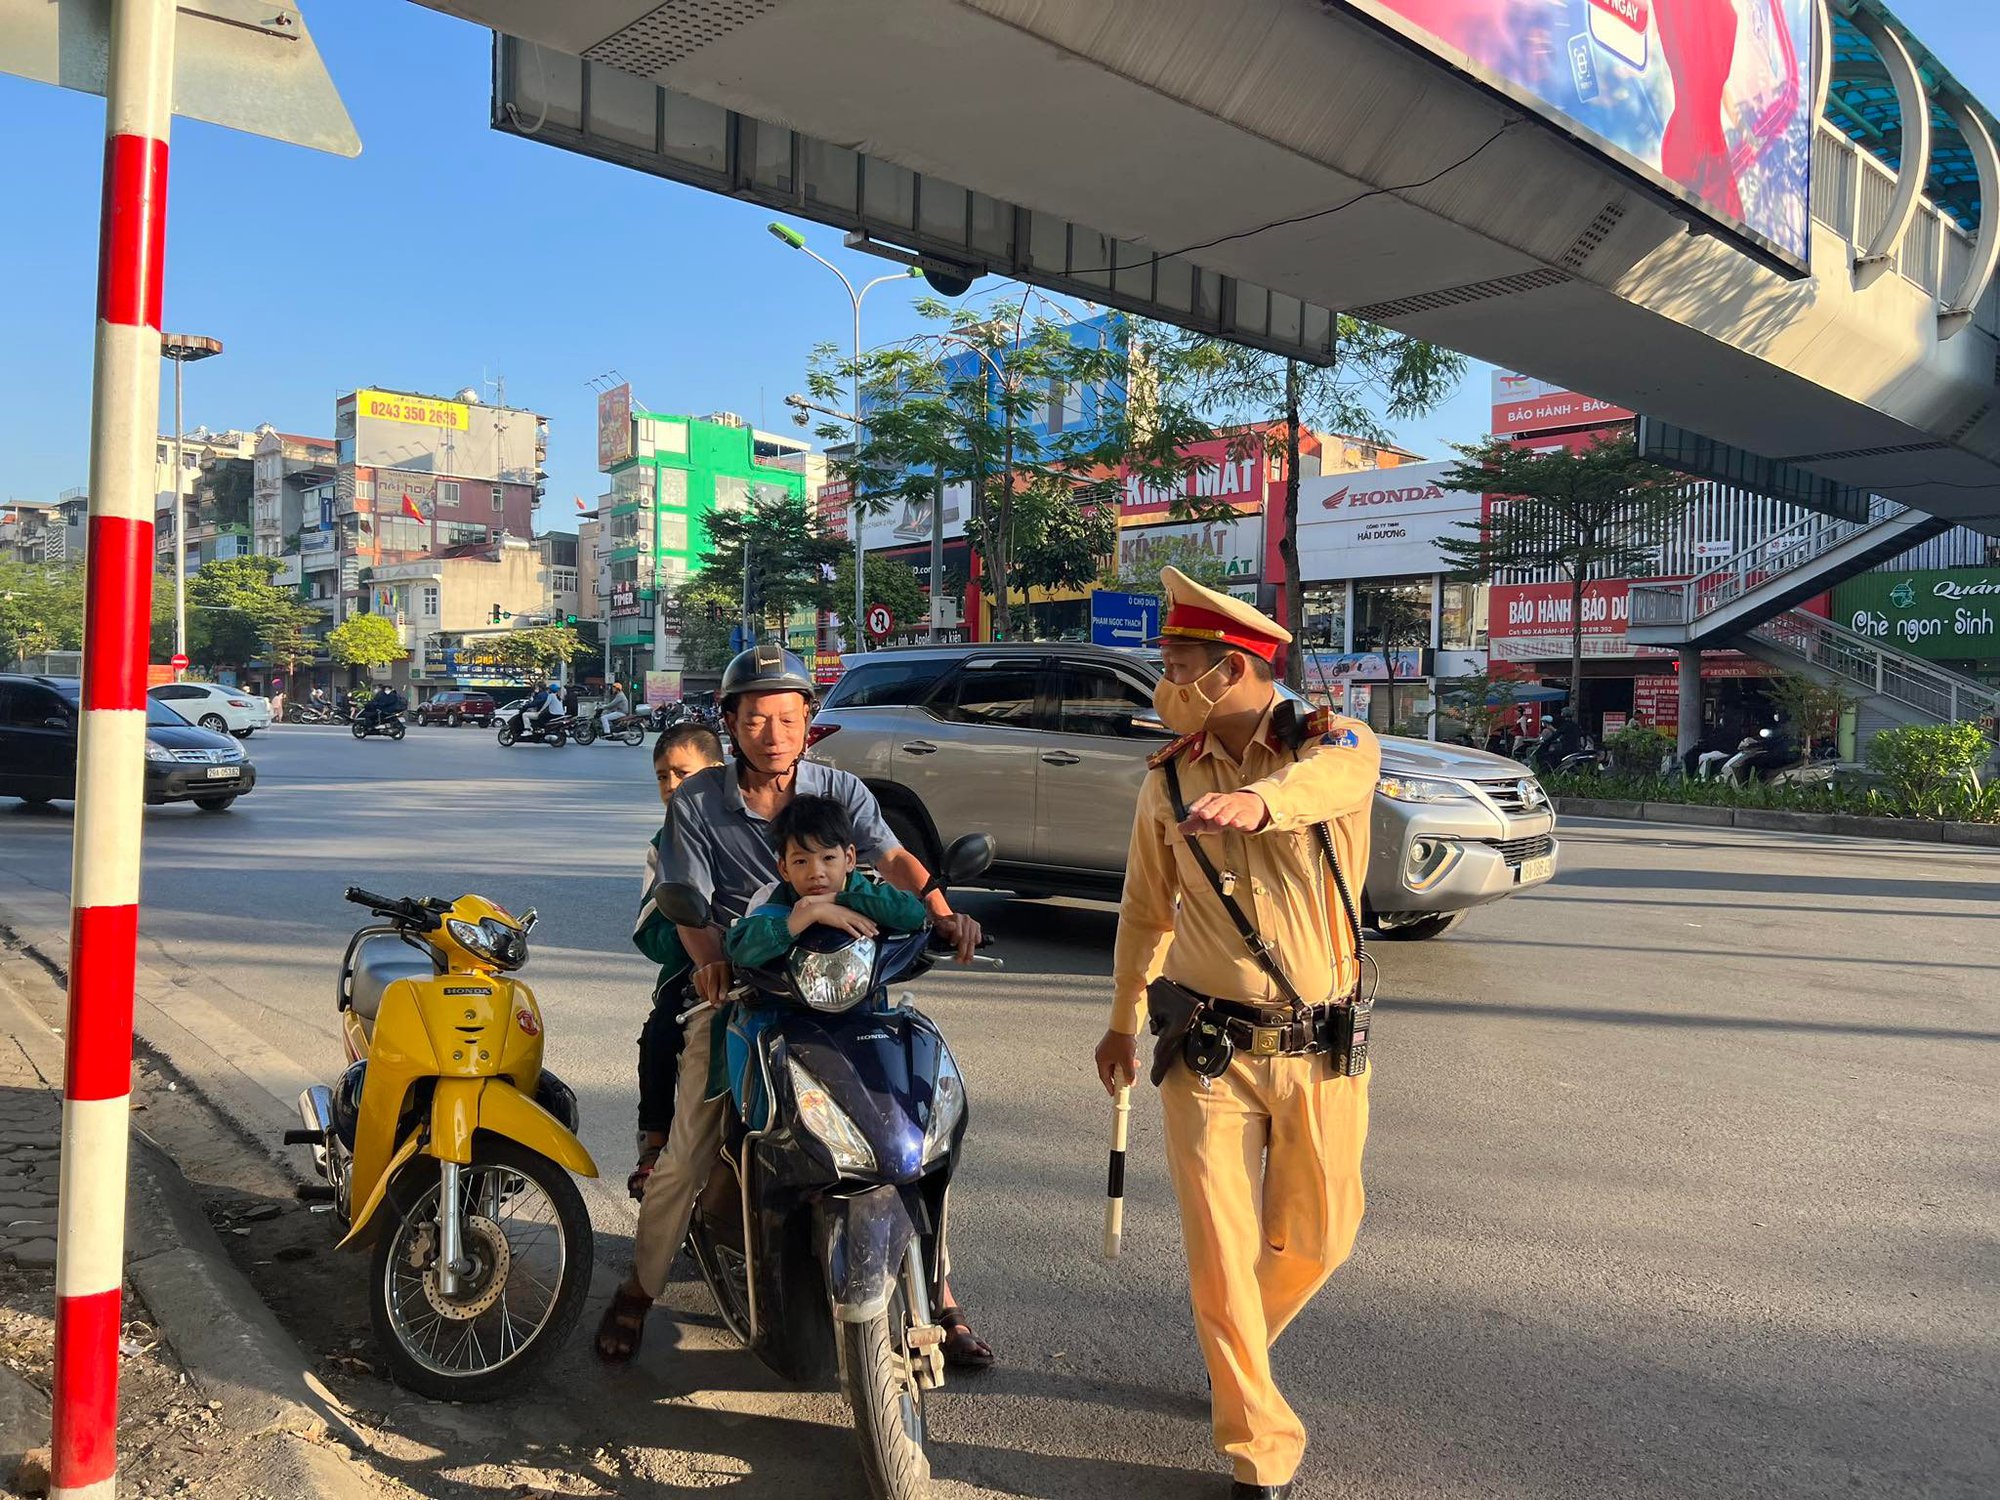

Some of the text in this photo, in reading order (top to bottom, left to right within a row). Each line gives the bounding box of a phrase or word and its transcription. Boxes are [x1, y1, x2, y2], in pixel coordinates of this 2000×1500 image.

[371, 401, 400, 418] 0243
[404, 406, 425, 421] 350
[1508, 407, 1532, 422] BẢO
[1536, 404, 1571, 418] HÀNH
[1348, 486, 1444, 507] HONDA
[1358, 529, 1406, 540] HẢI DƯƠNG
[1509, 592, 1533, 624] BẢO
[1538, 594, 1572, 623] HÀNH
[1581, 589, 1607, 621] BẢO
[1852, 610, 1889, 636] Chè
[1896, 618, 1941, 643] ngon
[1954, 608, 1993, 634] Sinh
